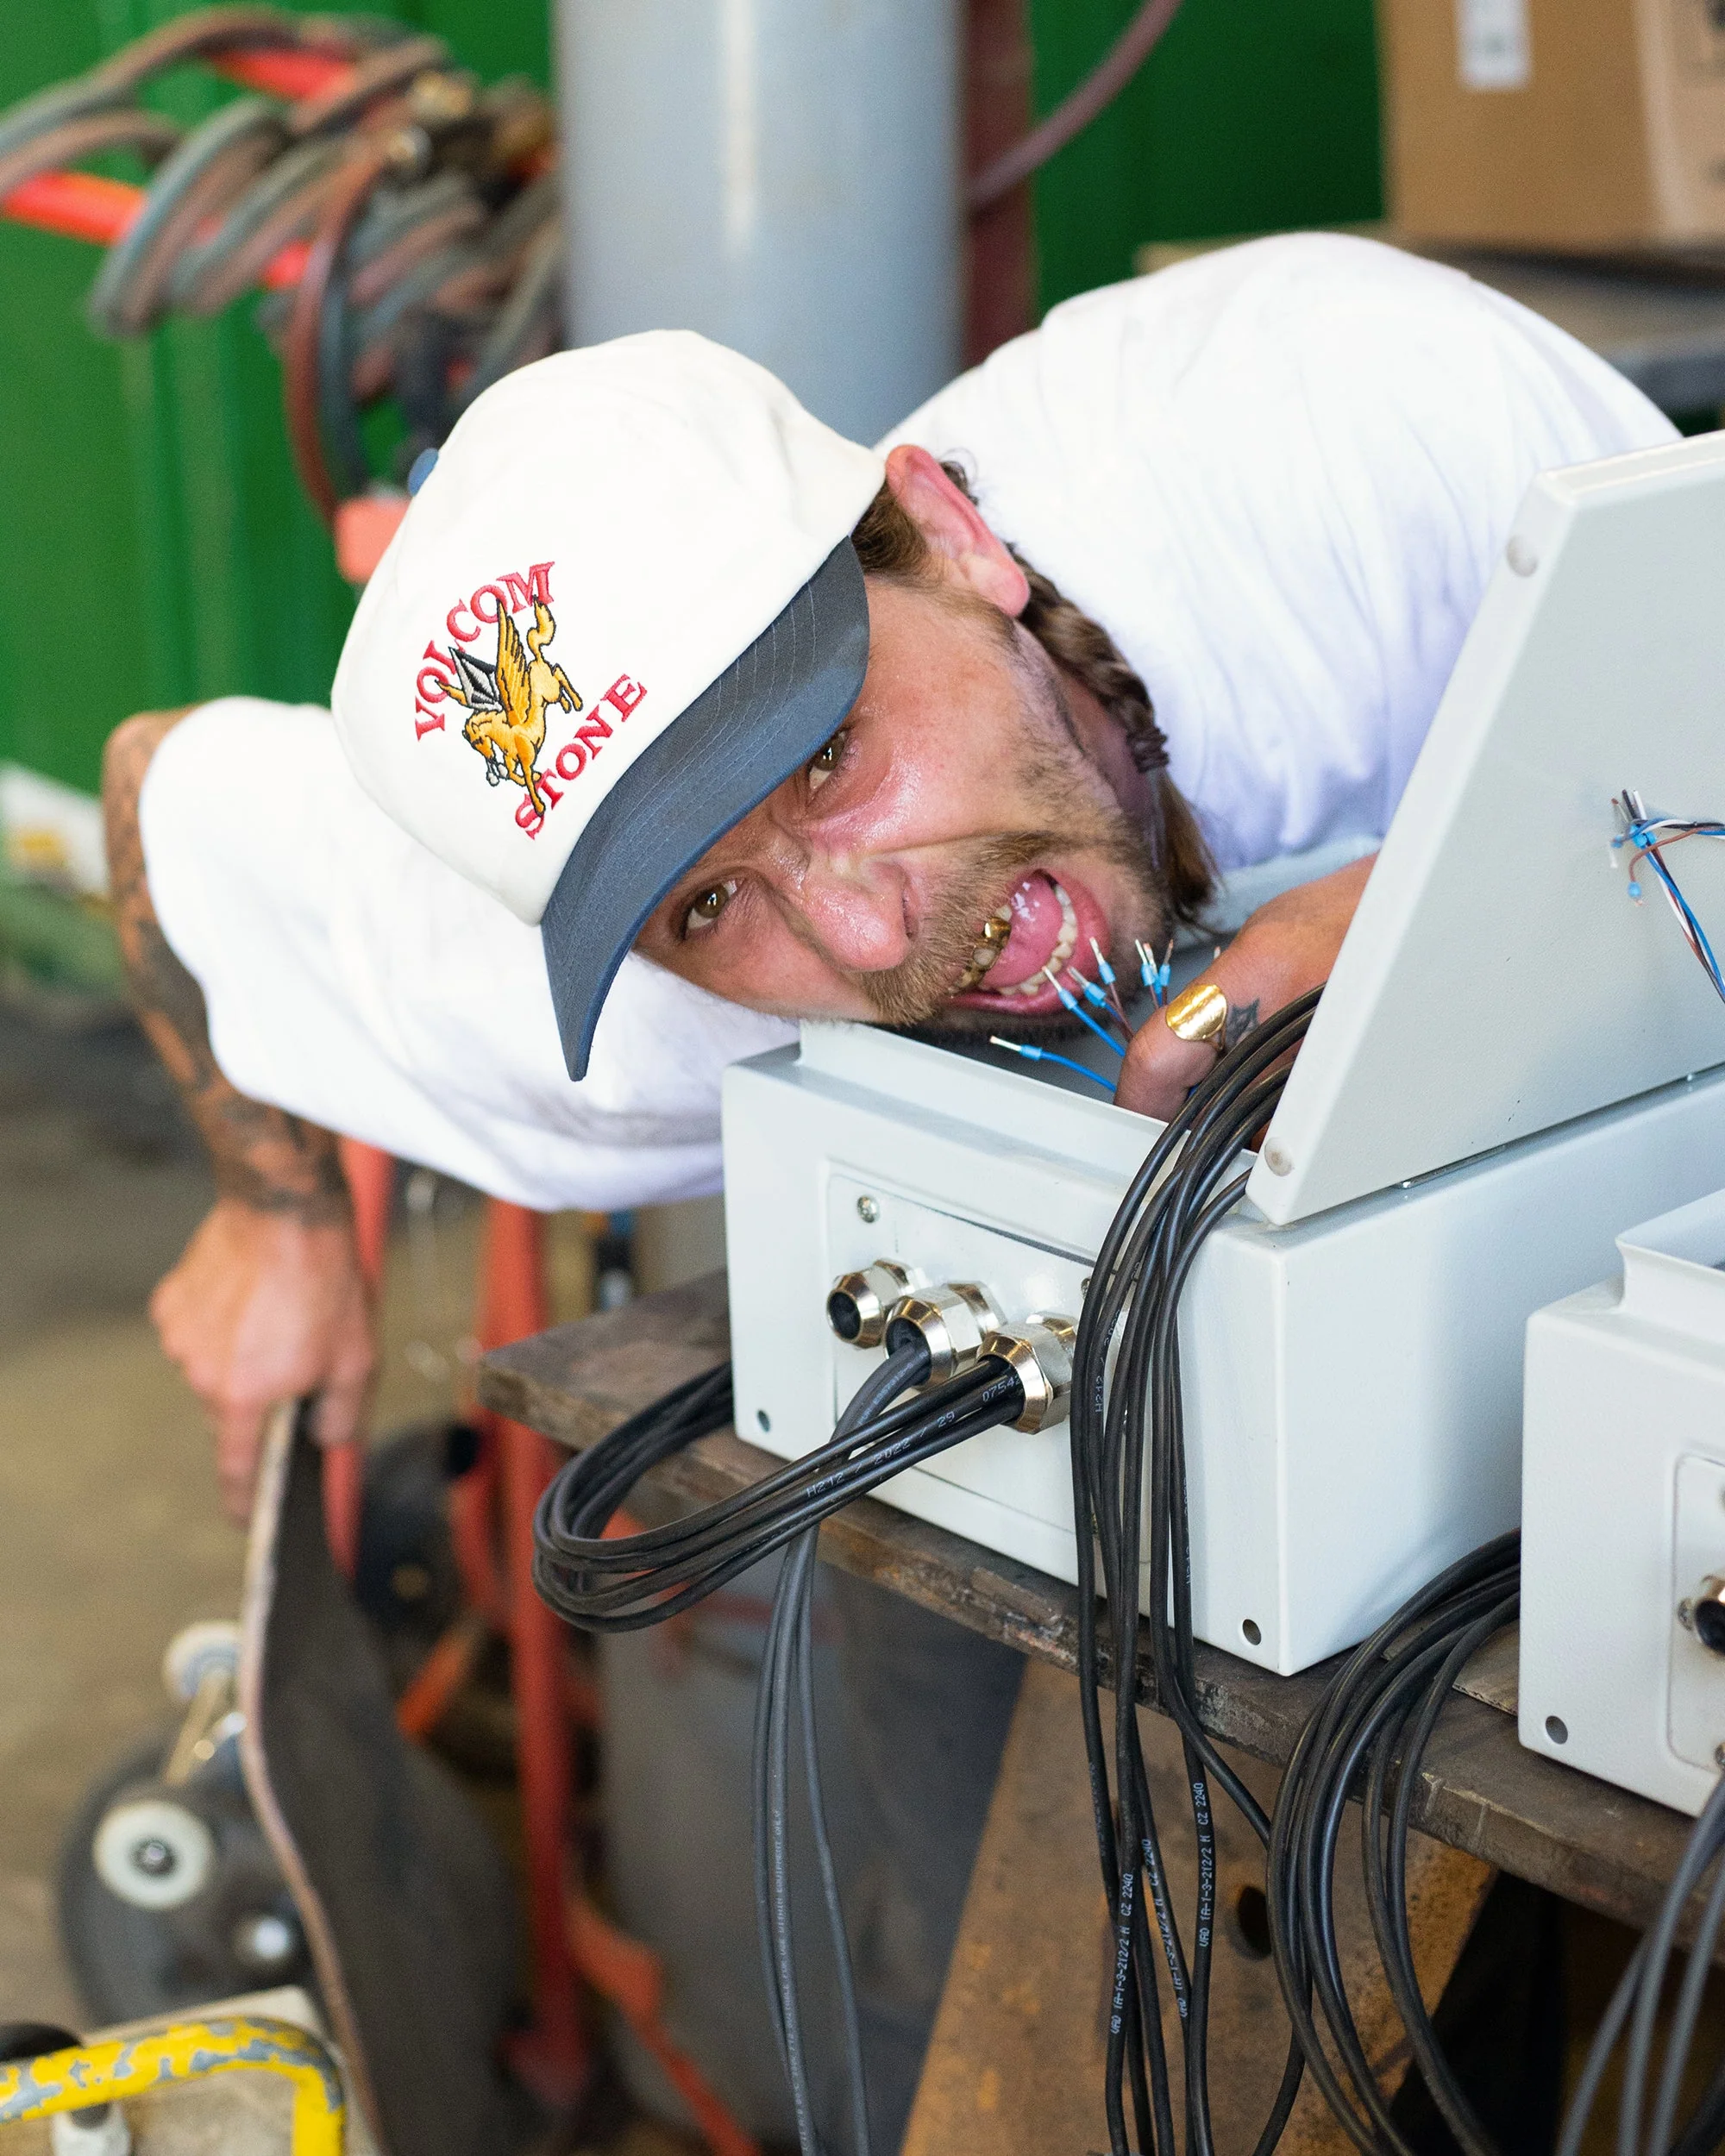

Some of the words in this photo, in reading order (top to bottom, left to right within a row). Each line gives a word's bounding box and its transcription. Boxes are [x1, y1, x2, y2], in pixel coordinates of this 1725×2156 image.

[415, 561, 555, 741] VOLCOM
[515, 674, 648, 840] STONE
[806, 1471, 845, 1498] H212
[874, 1437, 912, 1464] 2022
[937, 1412, 955, 1429] 29
[1192, 1782, 1206, 1807] 2240
[1197, 1812, 1208, 1826] CZ
[1121, 1871, 1133, 1900] 2240
[1120, 1902, 1132, 1917] CZ
